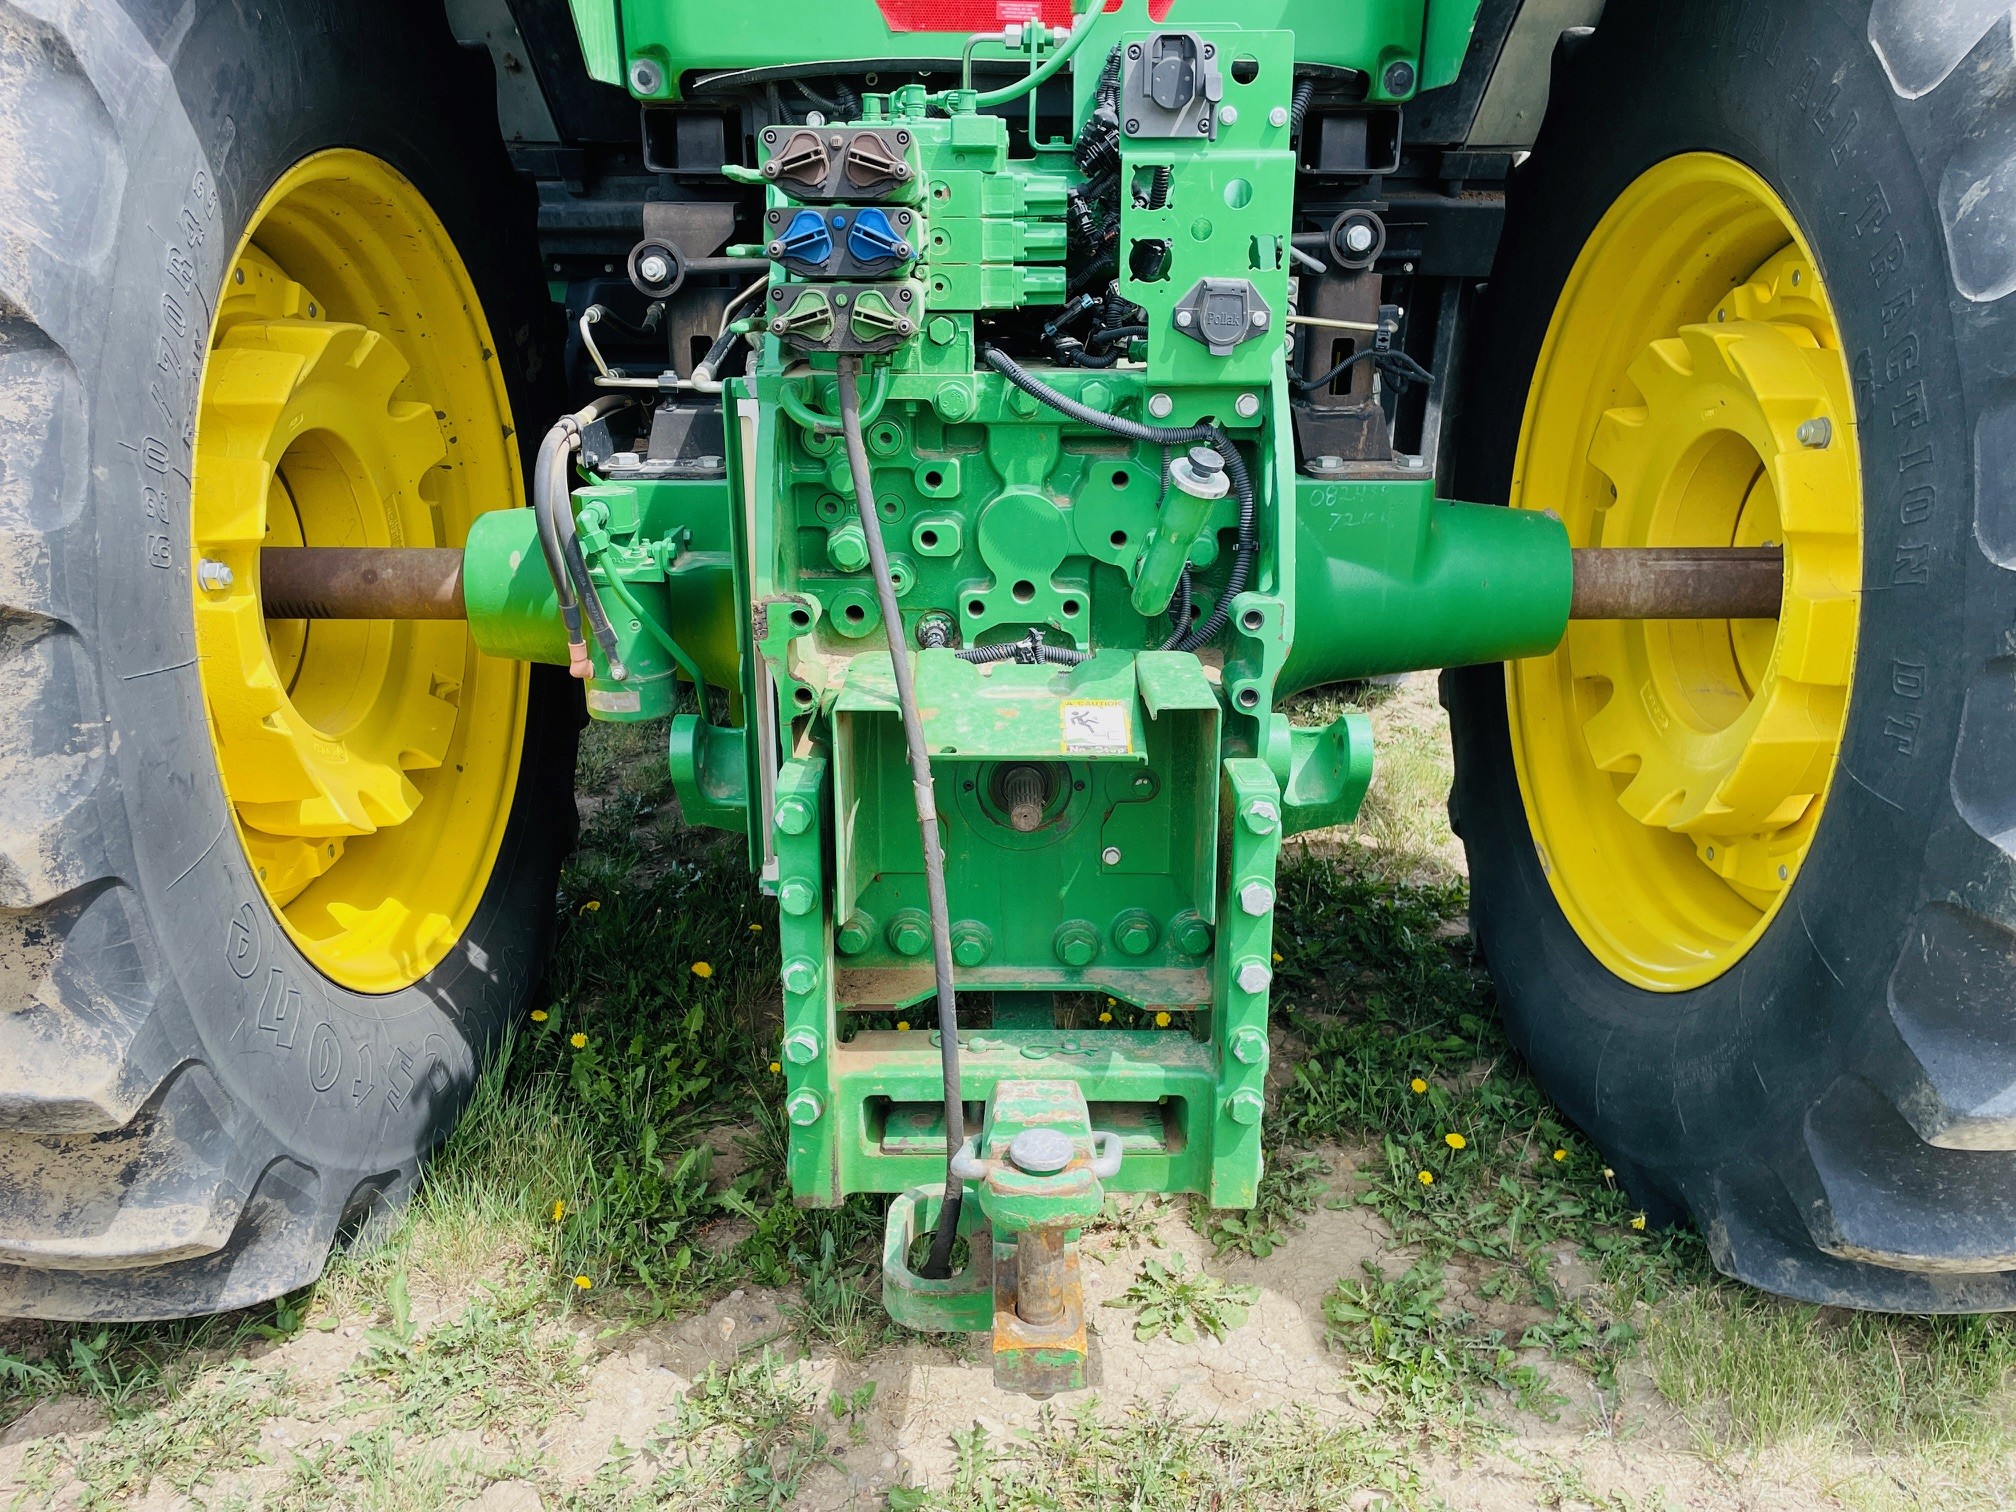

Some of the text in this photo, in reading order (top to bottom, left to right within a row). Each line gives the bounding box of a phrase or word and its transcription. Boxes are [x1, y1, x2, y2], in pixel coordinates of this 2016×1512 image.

[1791, 57, 1859, 168] ALL
[1207, 311, 1240, 327] Pollak
[1854, 182, 1936, 586] TRACTION
[1884, 658, 1926, 757] DT
